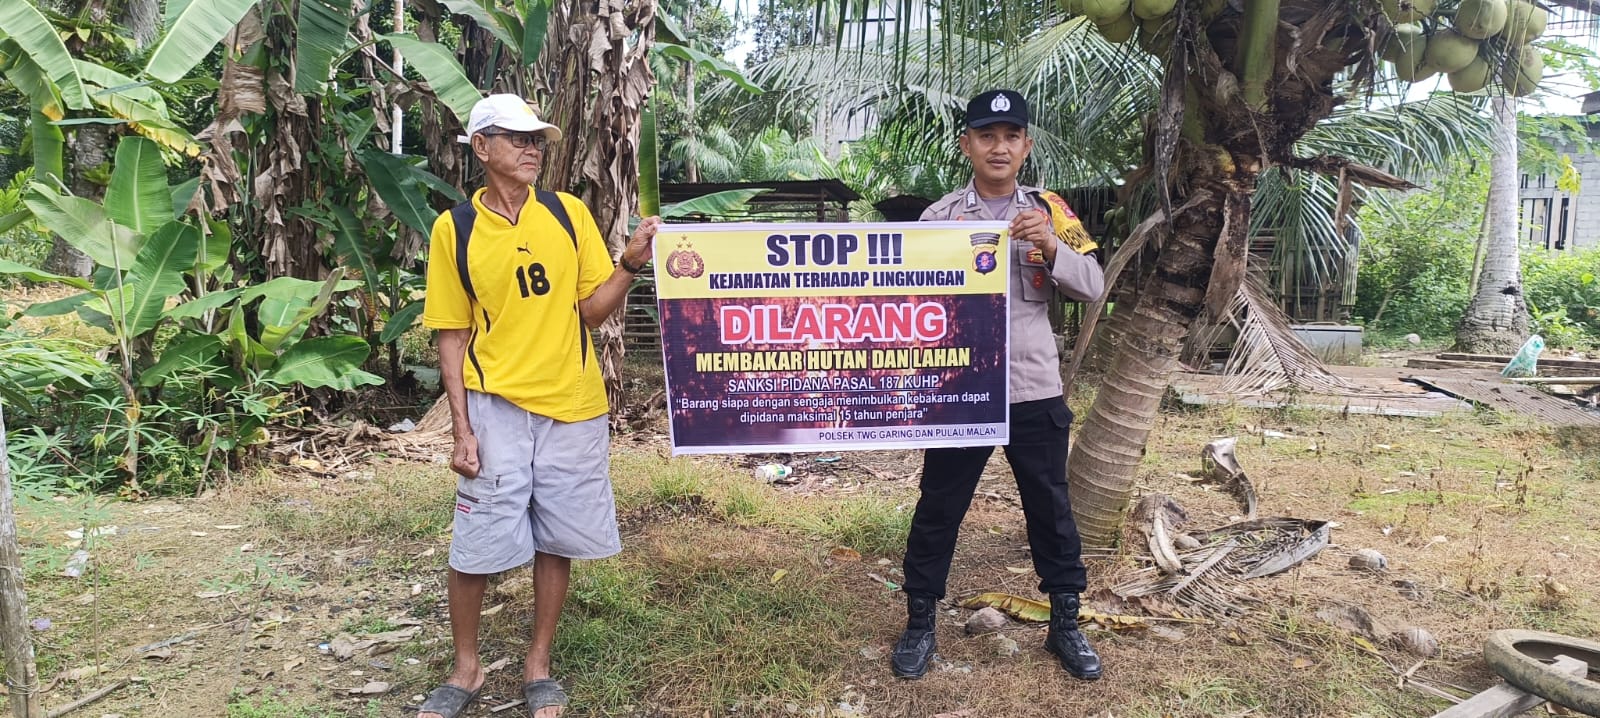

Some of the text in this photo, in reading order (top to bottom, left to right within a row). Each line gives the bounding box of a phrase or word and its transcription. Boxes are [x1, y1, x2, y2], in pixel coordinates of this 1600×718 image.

[767, 234, 902, 266] STOP !!!
[516, 263, 550, 298] 18
[709, 270, 965, 289] KEJAHATAN TERHADAP LINGKUNGAN
[721, 302, 945, 344] DILARANG
[695, 347, 970, 372] MEMBAKAR HUTAN DAN LAHAN
[728, 375, 940, 392] SANKSI PIDANA PASAL 187 KUHP
[721, 397, 750, 410] siapa
[752, 397, 791, 410] dengan
[793, 396, 834, 409] sengaja
[836, 394, 905, 406] menimbulkan
[907, 392, 959, 403] kebakaran
[961, 391, 990, 403] dapat
[740, 411, 785, 424] dipidana
[787, 410, 836, 422] maksimal
[839, 410, 851, 421] 15
[854, 409, 883, 420] tahun
[819, 427, 996, 441] POLSEK TWG GARING DAN PULAU MALAN
